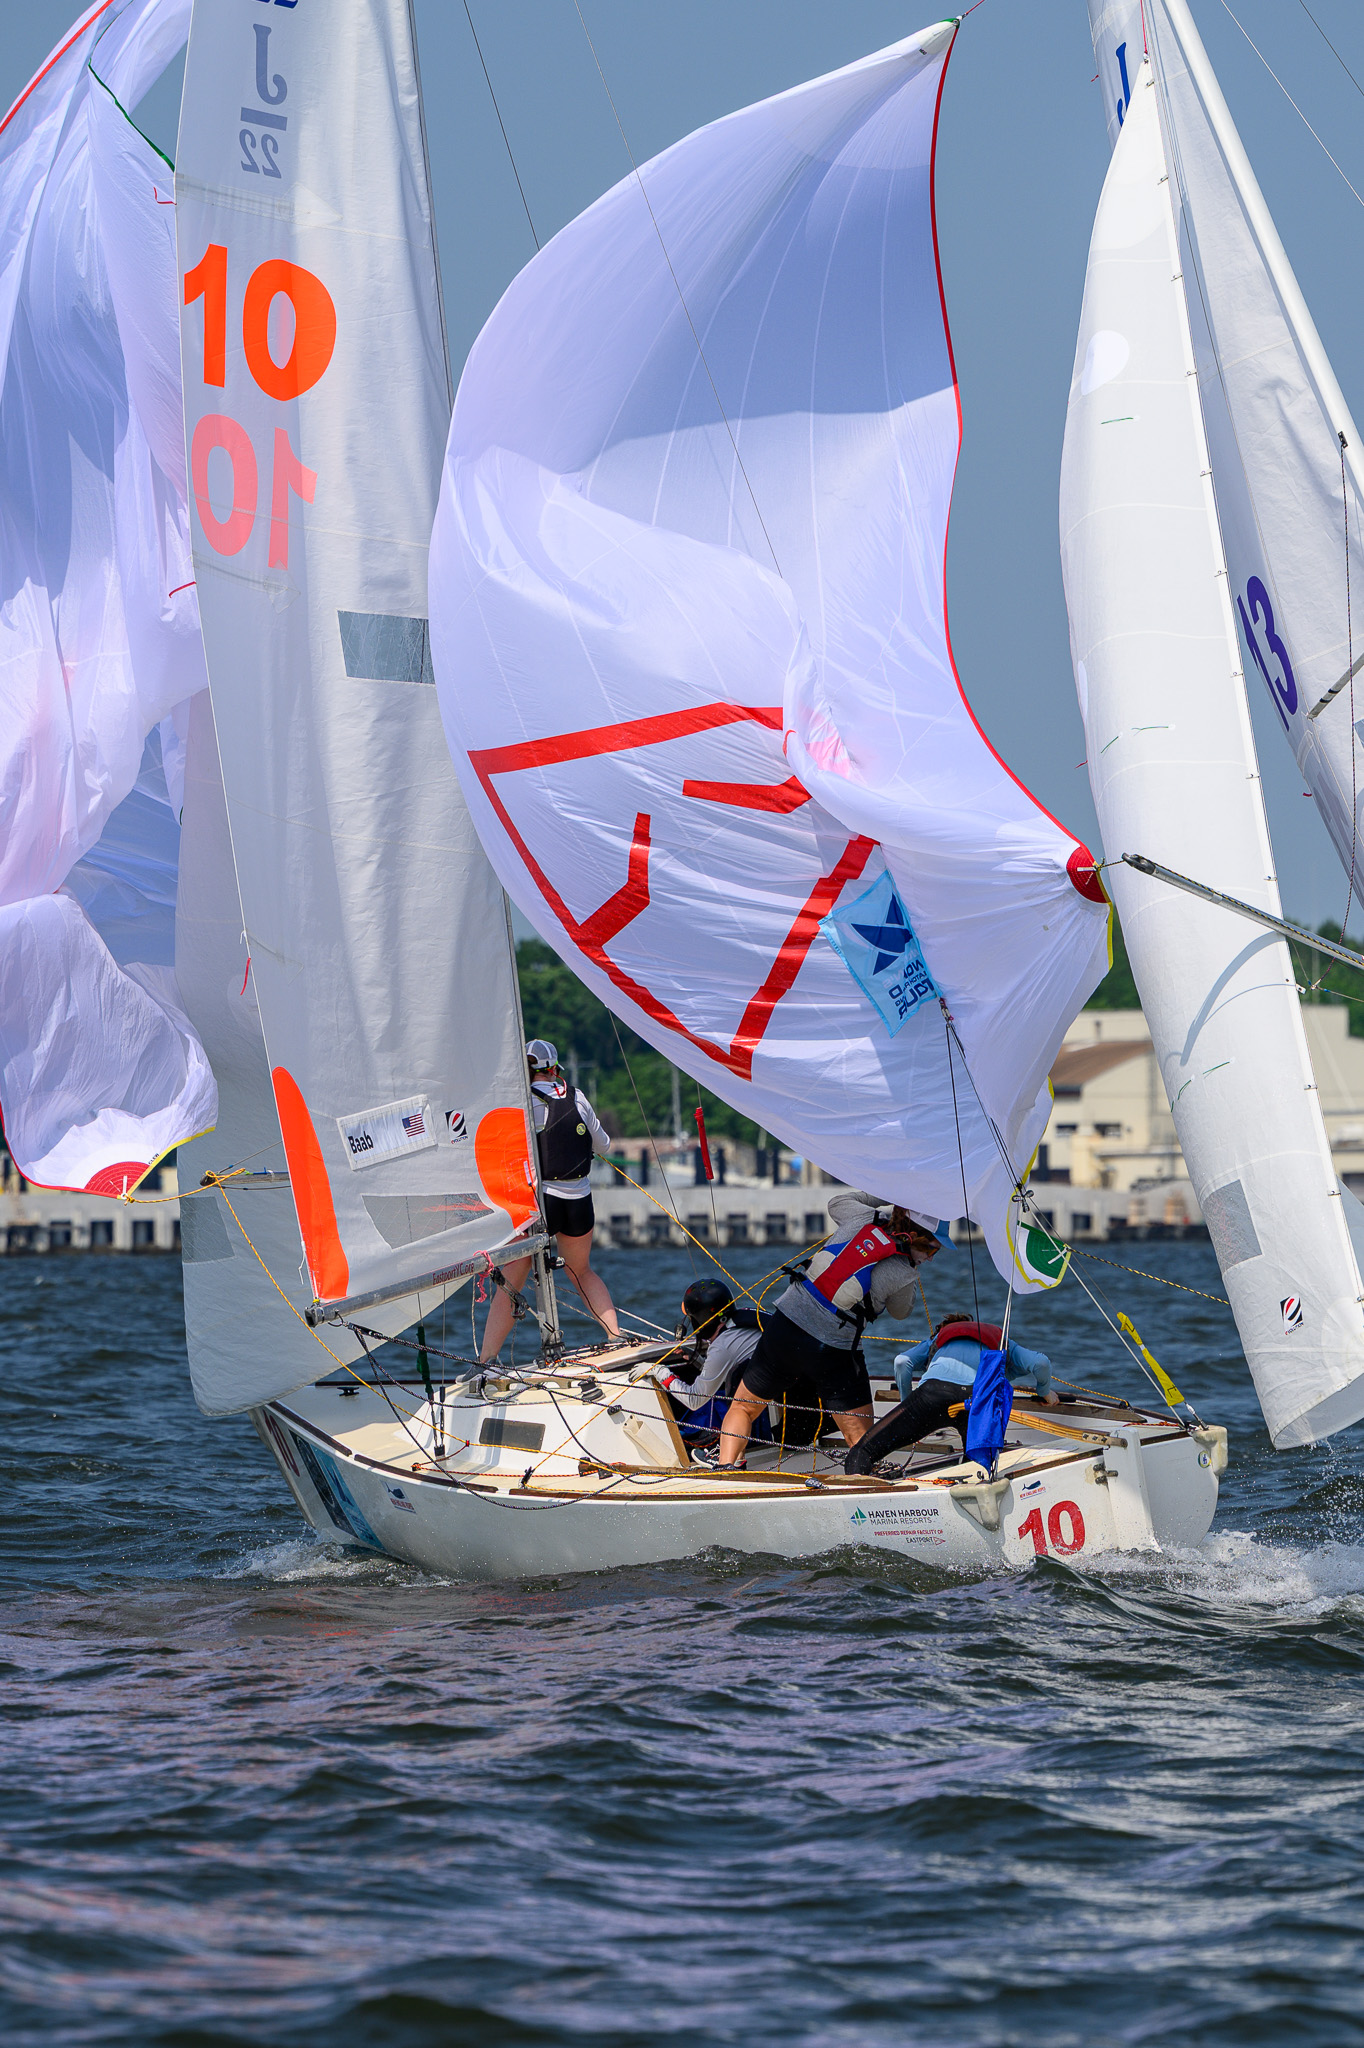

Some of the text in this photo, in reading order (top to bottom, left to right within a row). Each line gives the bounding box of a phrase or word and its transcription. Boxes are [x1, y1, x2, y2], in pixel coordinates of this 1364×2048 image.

[184, 243, 337, 401] 10
[1237, 575, 1298, 732] 13
[347, 1130, 374, 1154] Baab
[868, 1508, 939, 1519] HAVEN HARBOUR
[870, 1516, 932, 1526] MARINA RESORTS
[905, 1536, 934, 1544] EASTPORT
[1018, 1500, 1085, 1556] 10
